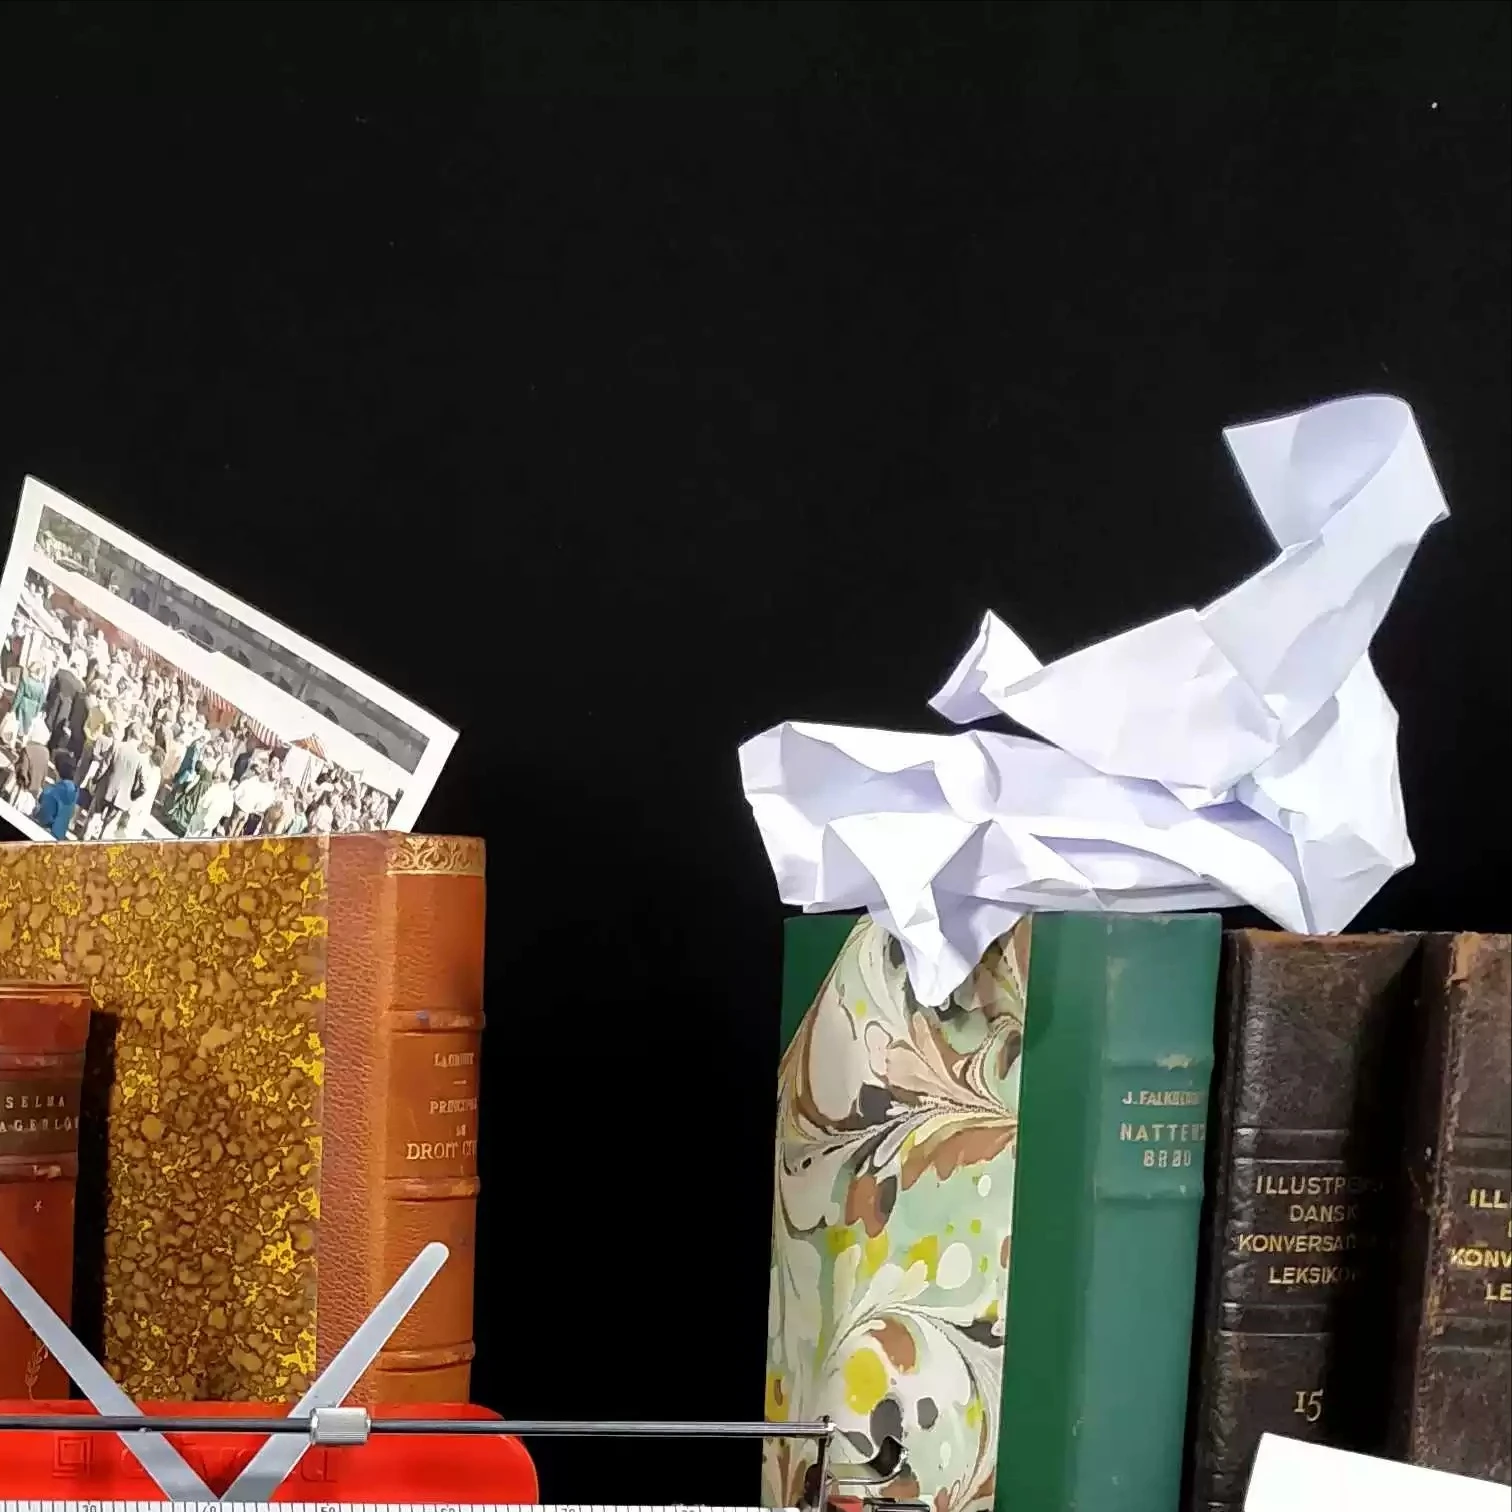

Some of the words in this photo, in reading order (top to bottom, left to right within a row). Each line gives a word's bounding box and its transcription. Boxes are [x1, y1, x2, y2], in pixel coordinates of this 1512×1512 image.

[5, 1096, 65, 1108] SELMA
[406, 1142, 459, 1160] DROIT
[1470, 1188, 1512, 1209] ILL
[1293, 1388, 1324, 1422] 15
